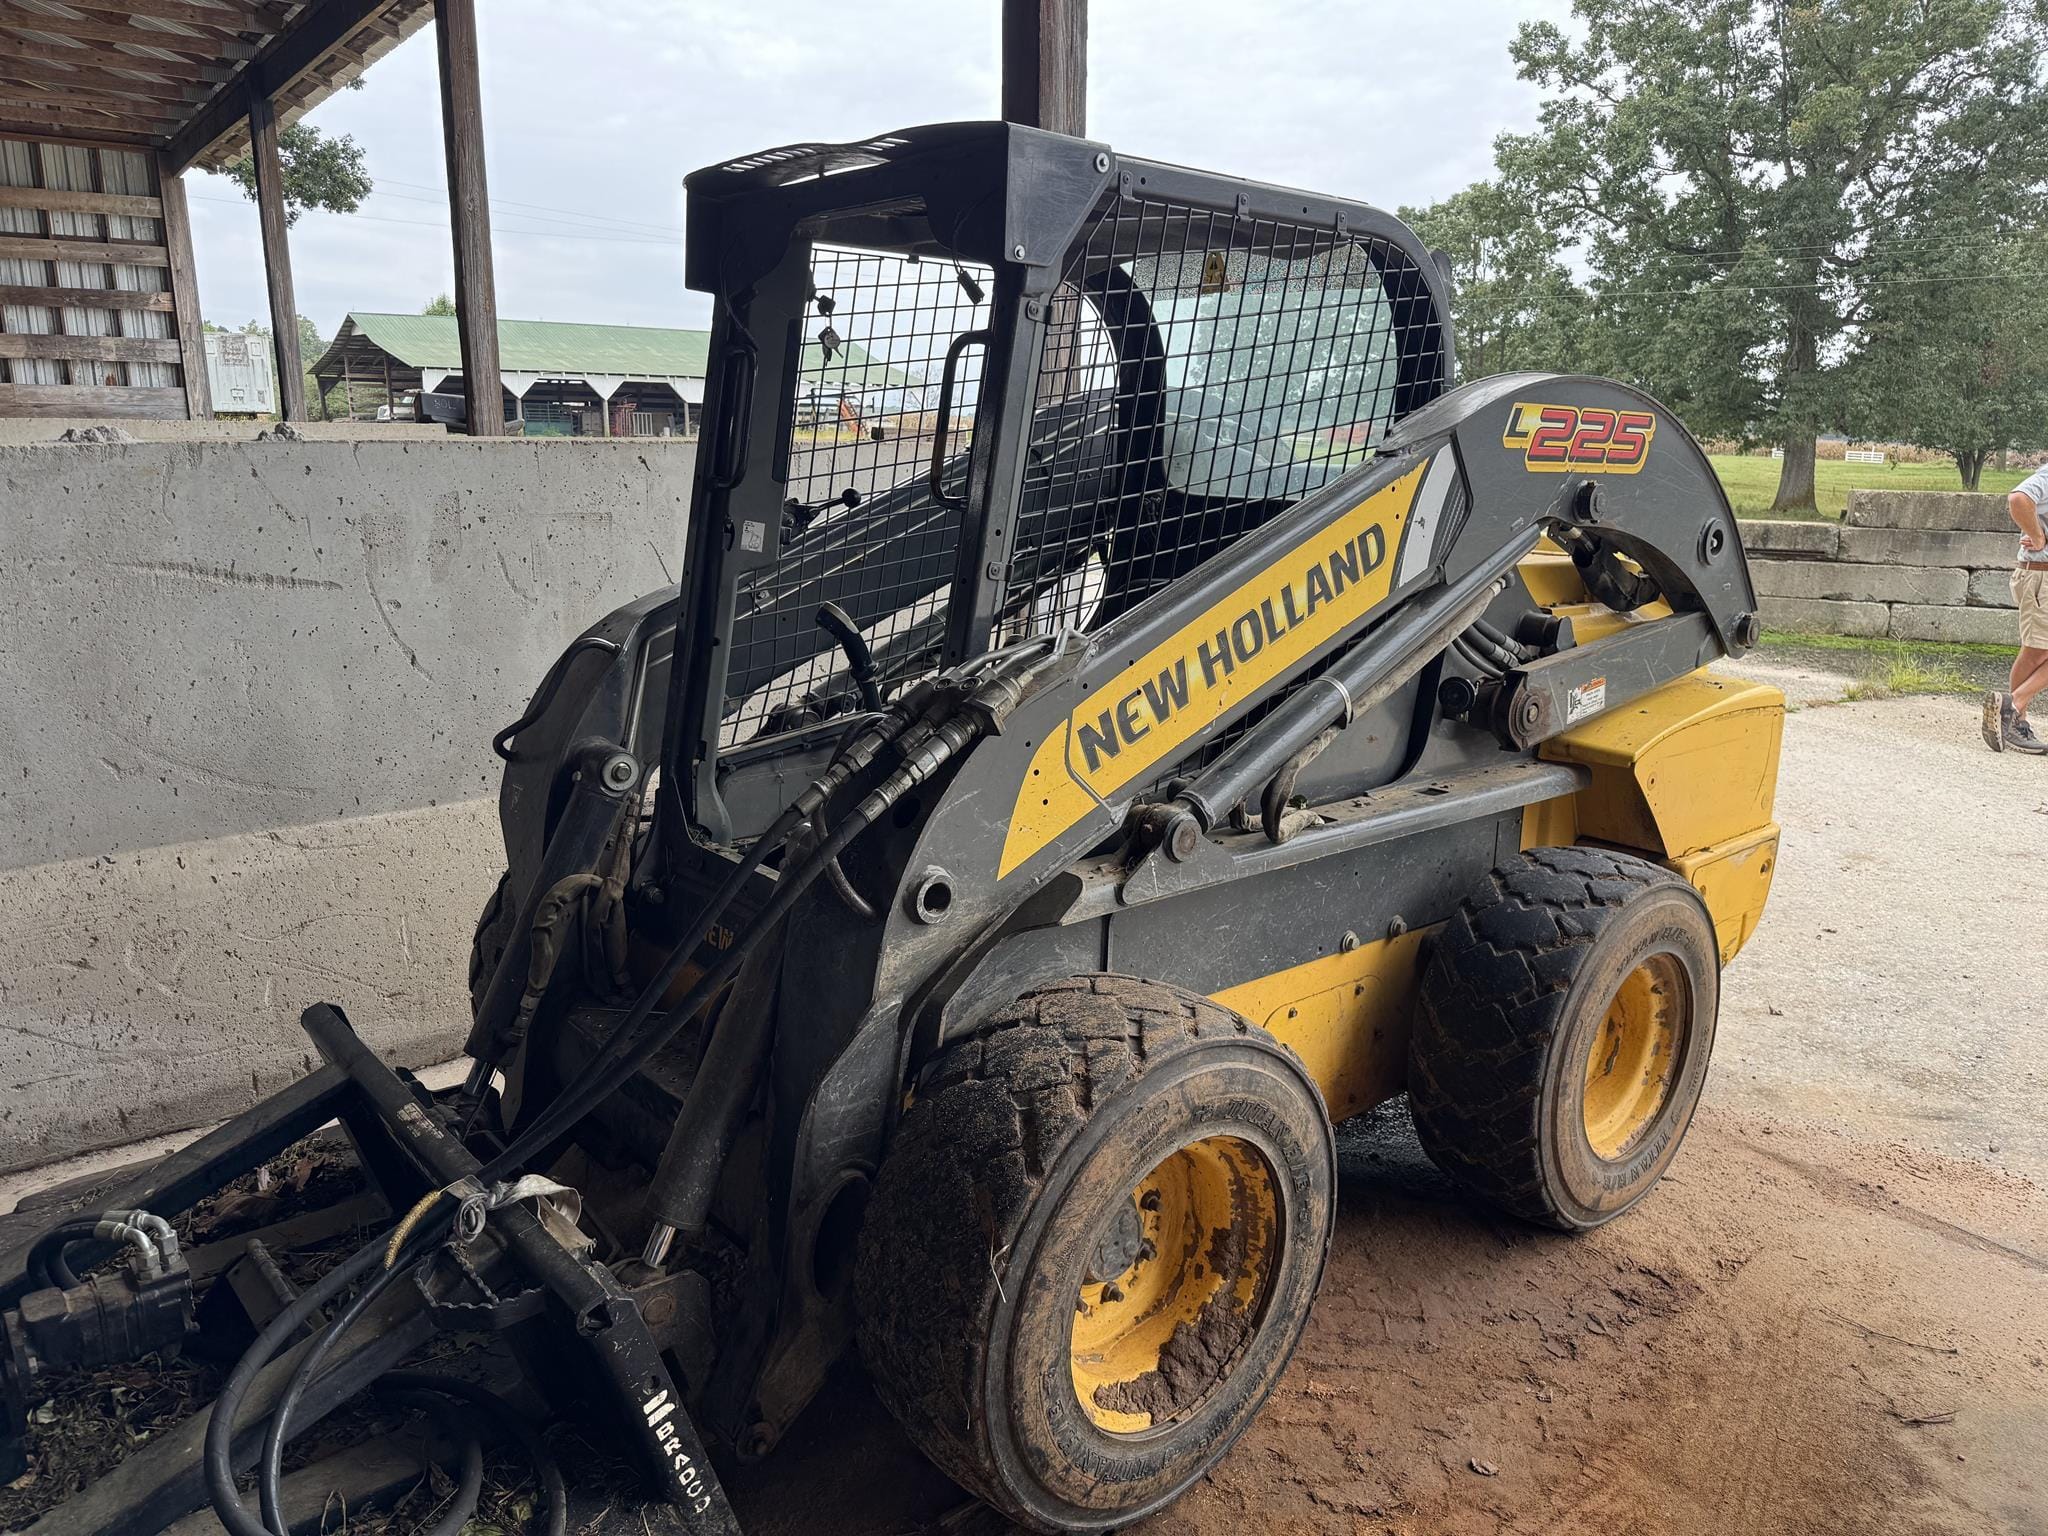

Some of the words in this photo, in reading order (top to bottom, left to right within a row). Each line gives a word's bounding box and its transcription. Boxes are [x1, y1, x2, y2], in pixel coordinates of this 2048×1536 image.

[1504, 403, 1655, 472] L225
[1076, 655, 1188, 775] NEW
[1197, 523, 1386, 690] HOLLAND
